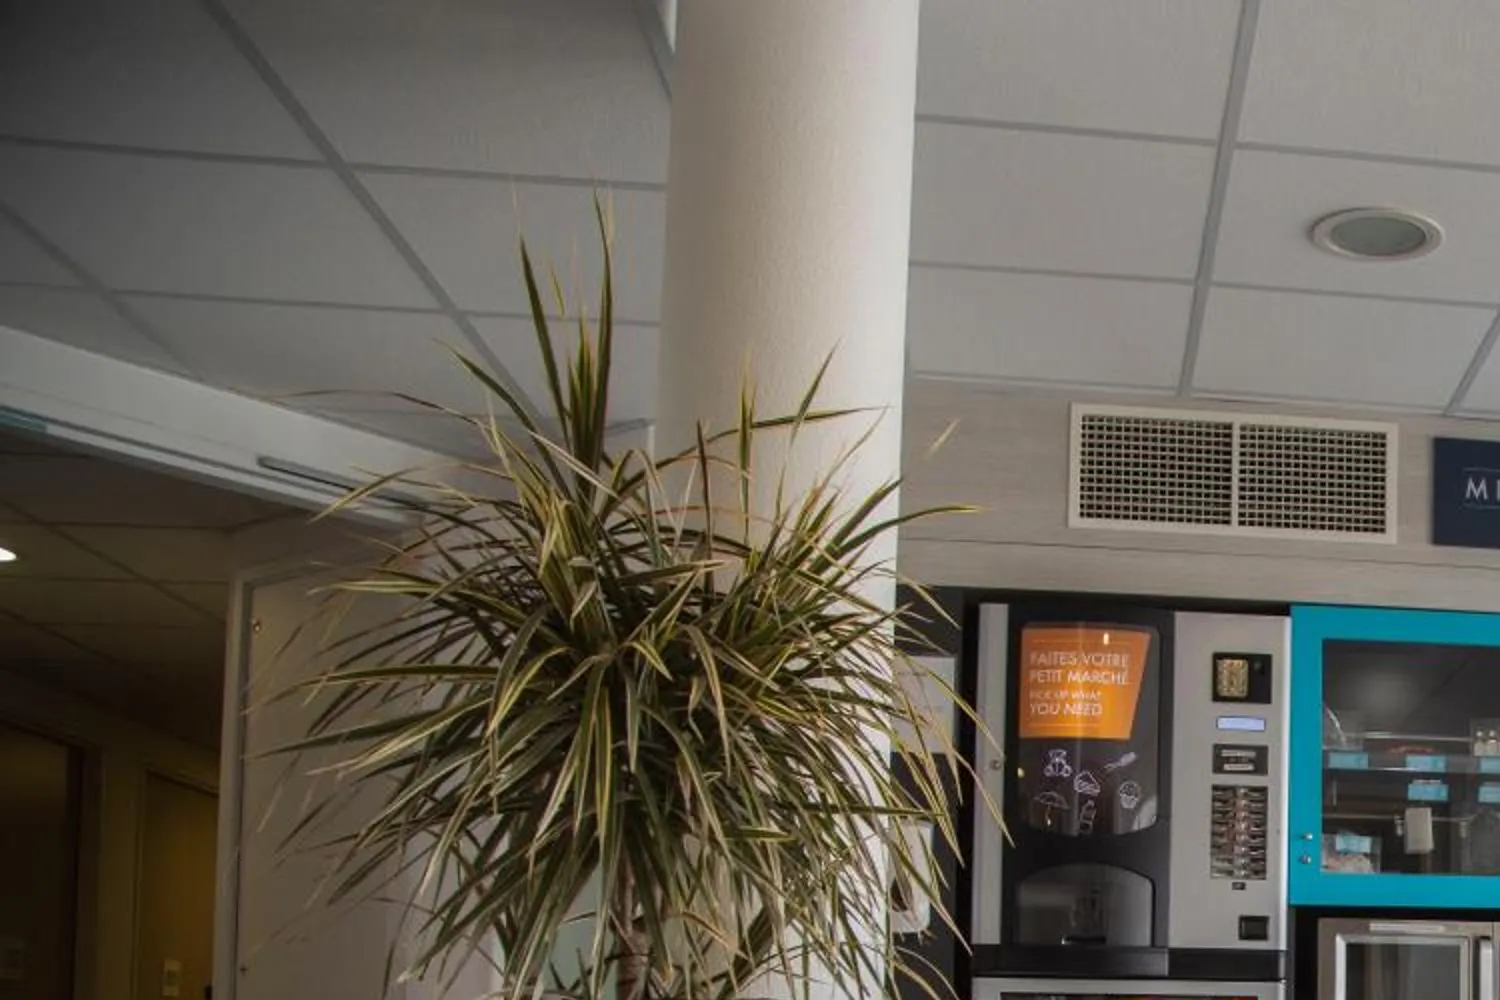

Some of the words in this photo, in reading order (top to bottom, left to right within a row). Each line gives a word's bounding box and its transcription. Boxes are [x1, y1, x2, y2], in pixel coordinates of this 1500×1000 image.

[1029, 651, 1078, 667] FAITES
[1081, 652, 1130, 668] VOTRE
[1029, 668, 1062, 684] PETIT
[1071, 690, 1102, 701] WHAT
[1029, 703, 1060, 716] YOU
[1063, 703, 1103, 716] NEED
